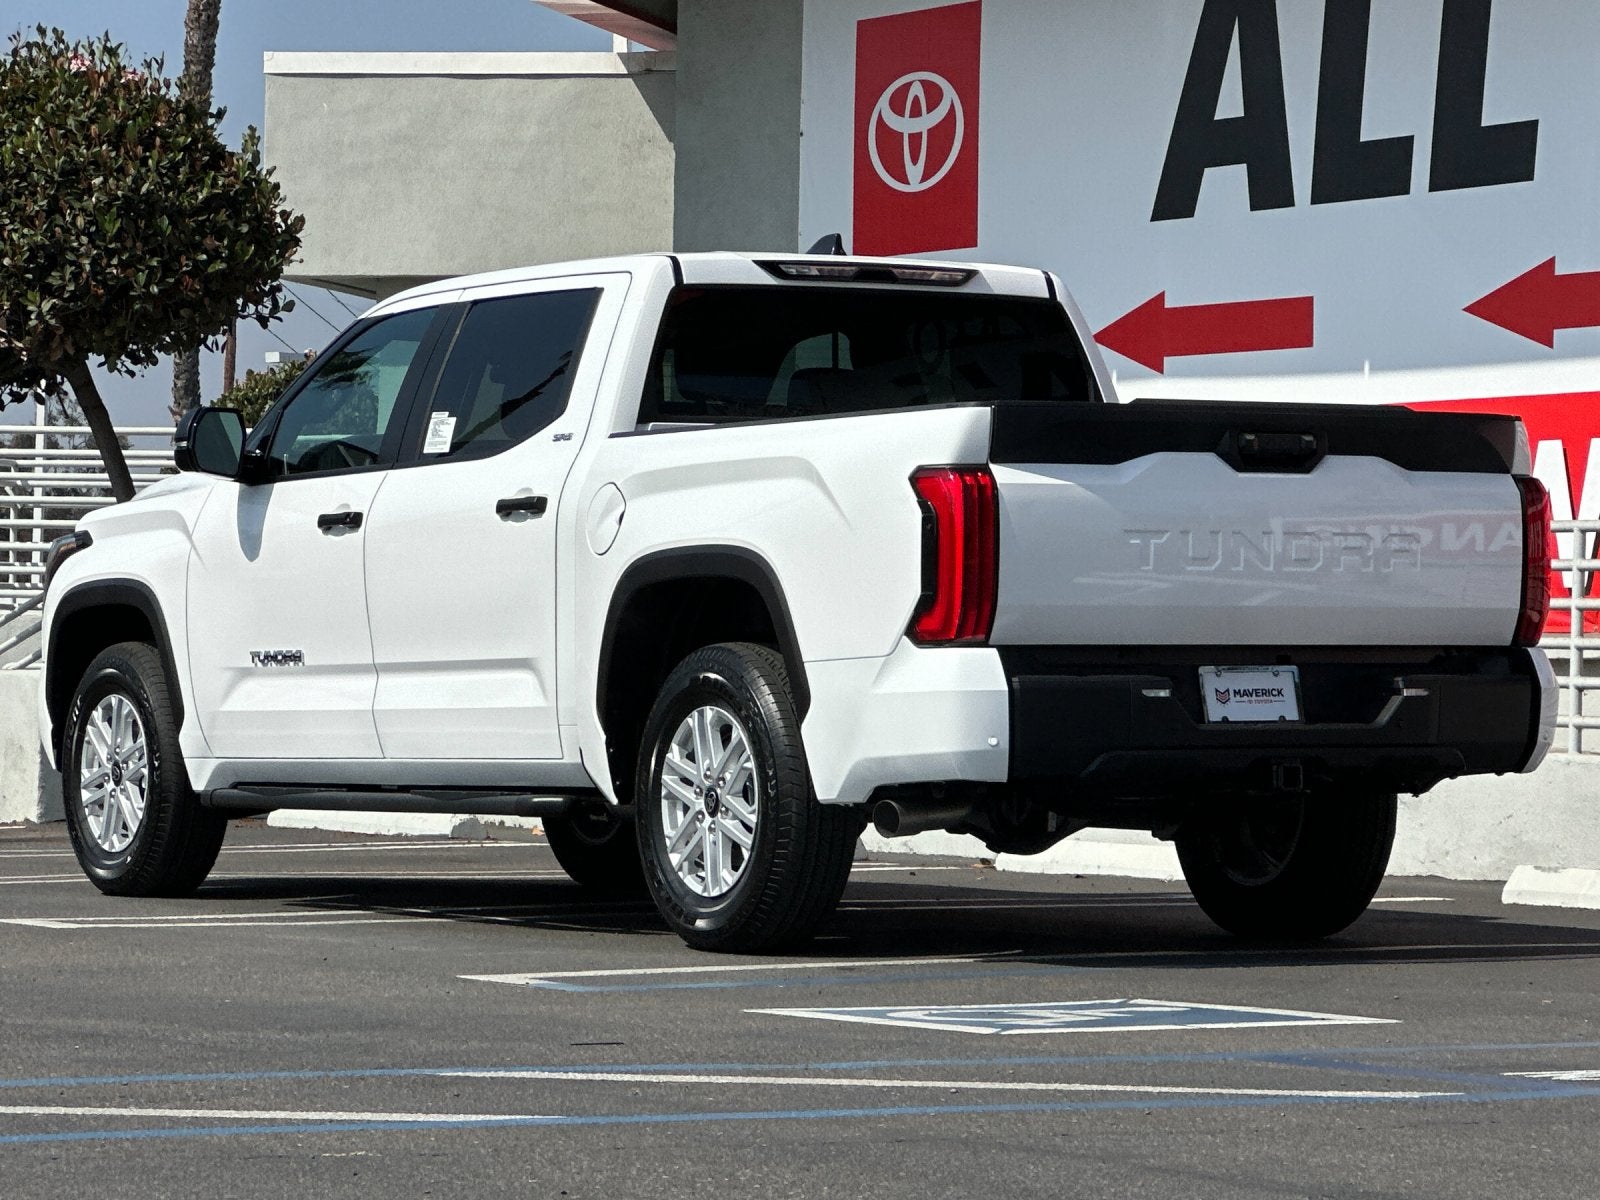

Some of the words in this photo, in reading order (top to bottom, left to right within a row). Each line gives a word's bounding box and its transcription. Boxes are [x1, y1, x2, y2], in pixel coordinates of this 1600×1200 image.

[1151, 0, 1538, 221] ALL
[1124, 528, 1422, 572] TUNDRA
[250, 650, 304, 666] TUNDRA
[1233, 688, 1284, 698] MAVERICK
